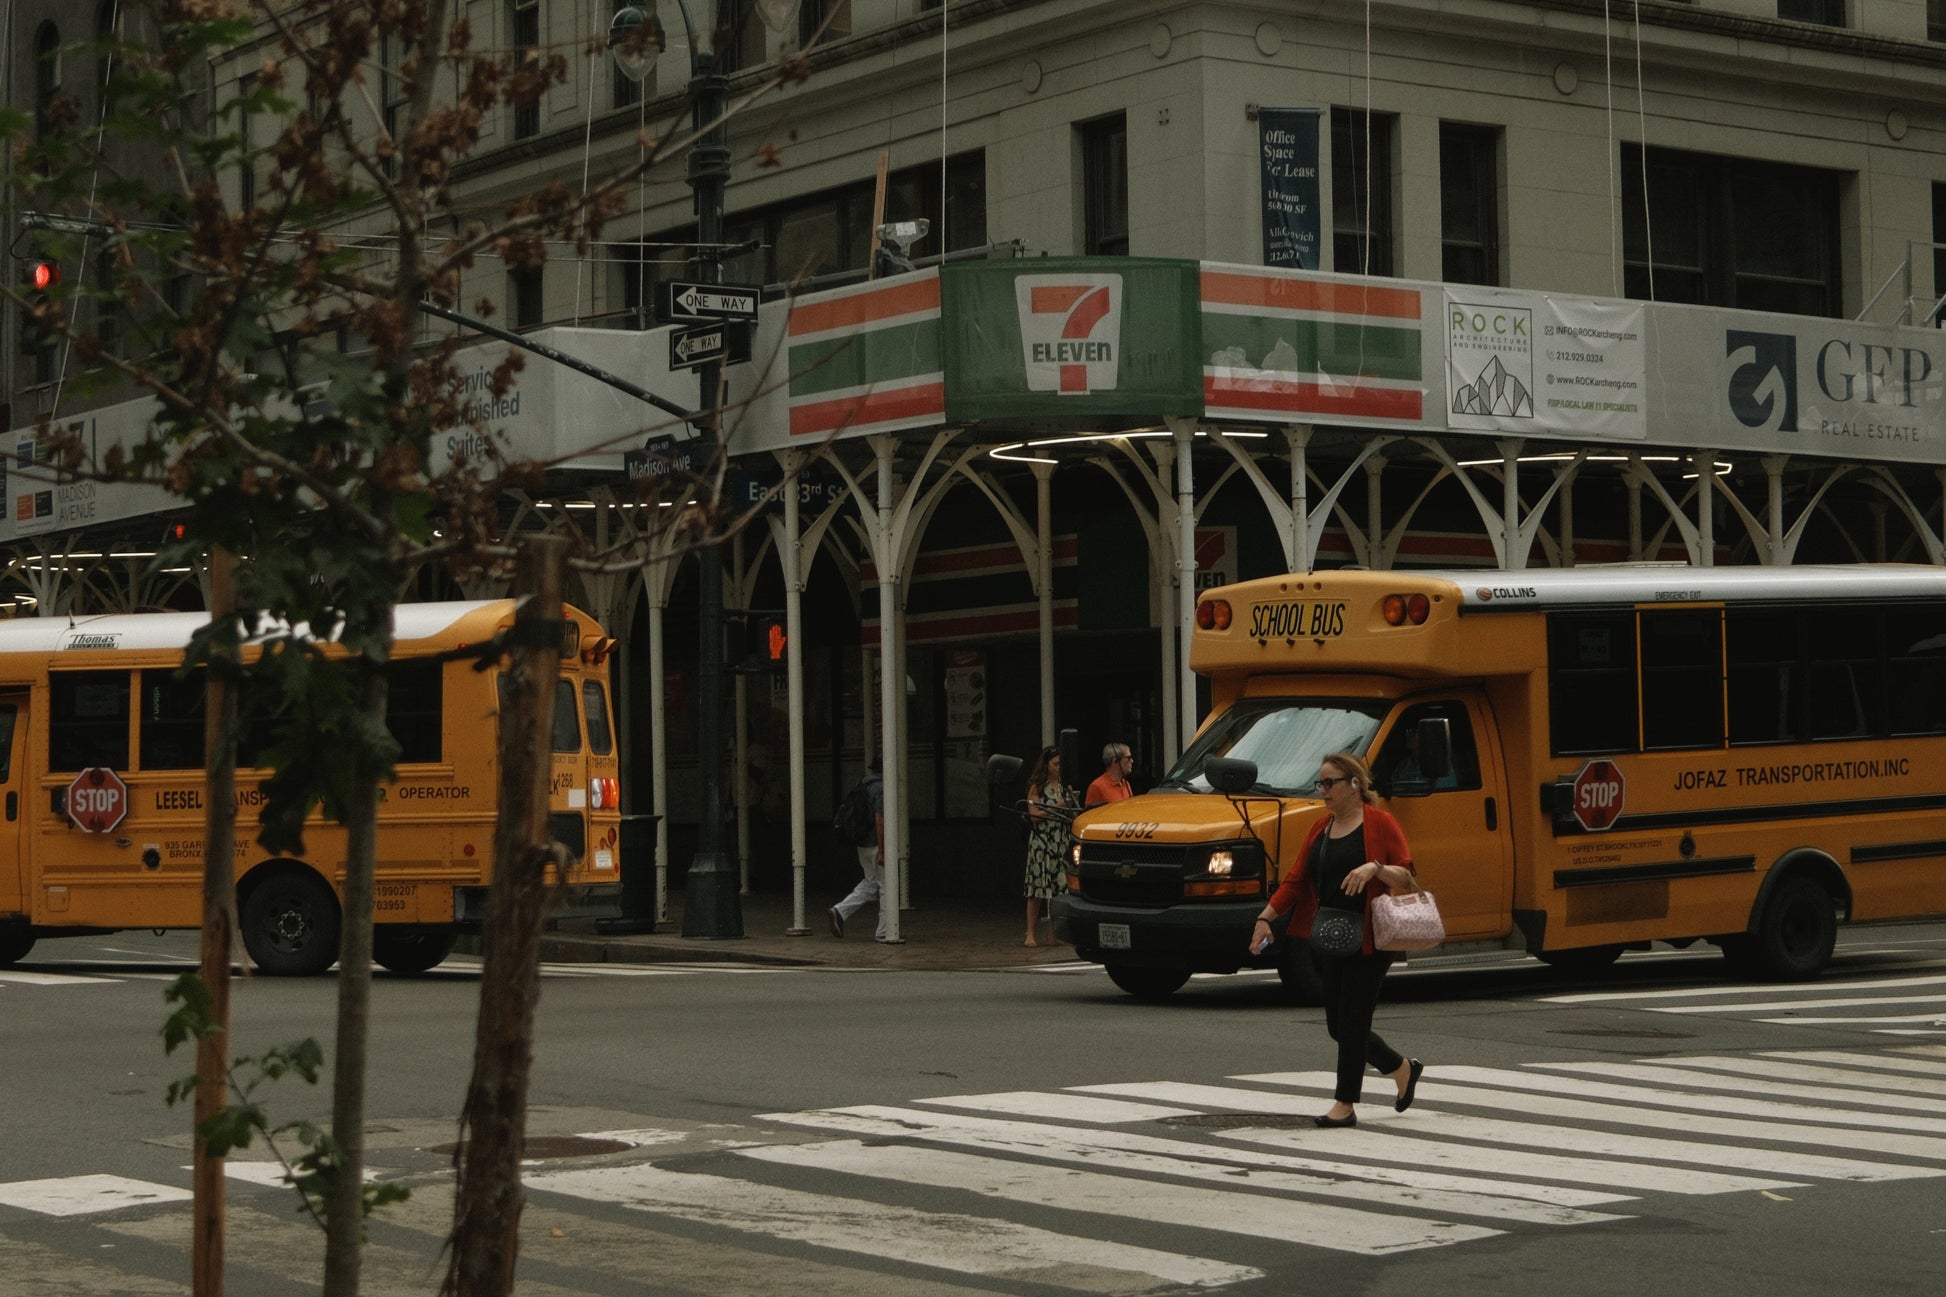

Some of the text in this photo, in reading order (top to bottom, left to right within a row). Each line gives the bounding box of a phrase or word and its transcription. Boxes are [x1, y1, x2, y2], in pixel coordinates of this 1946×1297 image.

[1265, 130, 1296, 145] Office
[1285, 163, 1315, 178] Lease
[685, 294, 747, 310] ONE WAY
[1452, 312, 1527, 336] ROCK
[681, 336, 718, 354] ONE WAY
[1556, 352, 1604, 363] 212.929.0324
[1817, 339, 1932, 408] GFP
[1821, 420, 1919, 442] REAL ESTATE
[629, 454, 691, 480] Madison Ave
[58, 484, 96, 504] MADISON
[60, 502, 96, 523] AVENUE
[1493, 587, 1536, 599] COLLINS
[1250, 603, 1345, 637] SCHOOL BUS
[70, 632, 120, 644] Thomas
[1674, 769, 1728, 790] JOFAZ
[75, 788, 119, 813] STOP
[155, 790, 203, 810] LEESEL
[399, 786, 470, 799] OPERATOR
[1579, 781, 1619, 808] STOP
[1115, 822, 1160, 839] 9932
